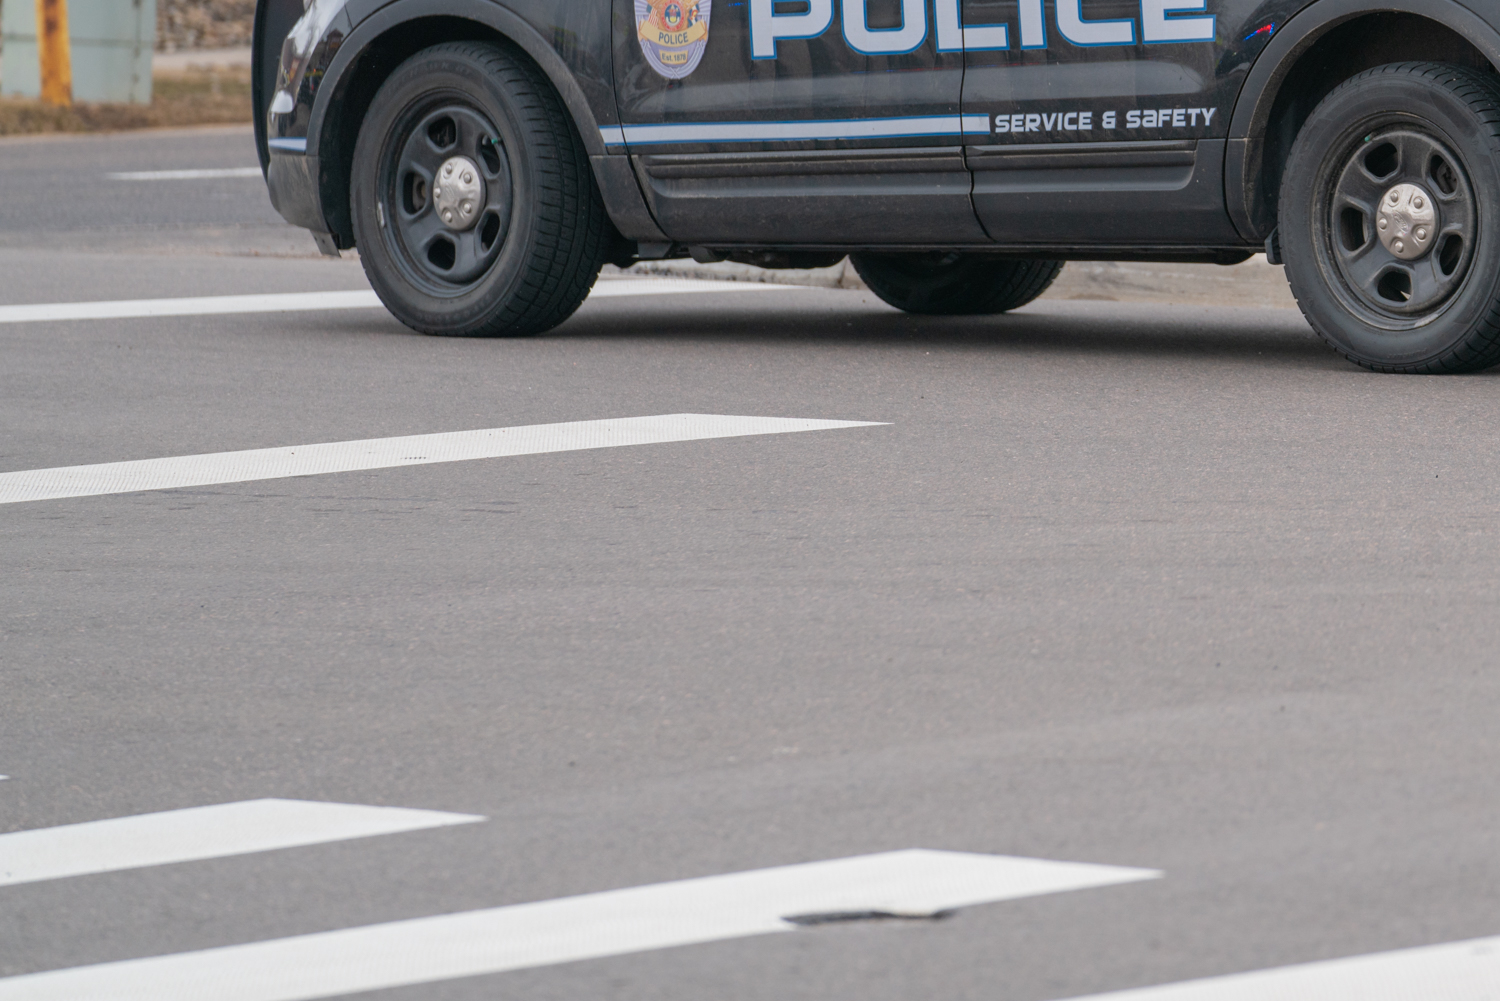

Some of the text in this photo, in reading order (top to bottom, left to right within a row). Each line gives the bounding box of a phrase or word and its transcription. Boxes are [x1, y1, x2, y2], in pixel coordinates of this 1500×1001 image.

[658, 31, 689, 45] POLICE
[995, 107, 1217, 133] SERVICE & SAFETY
